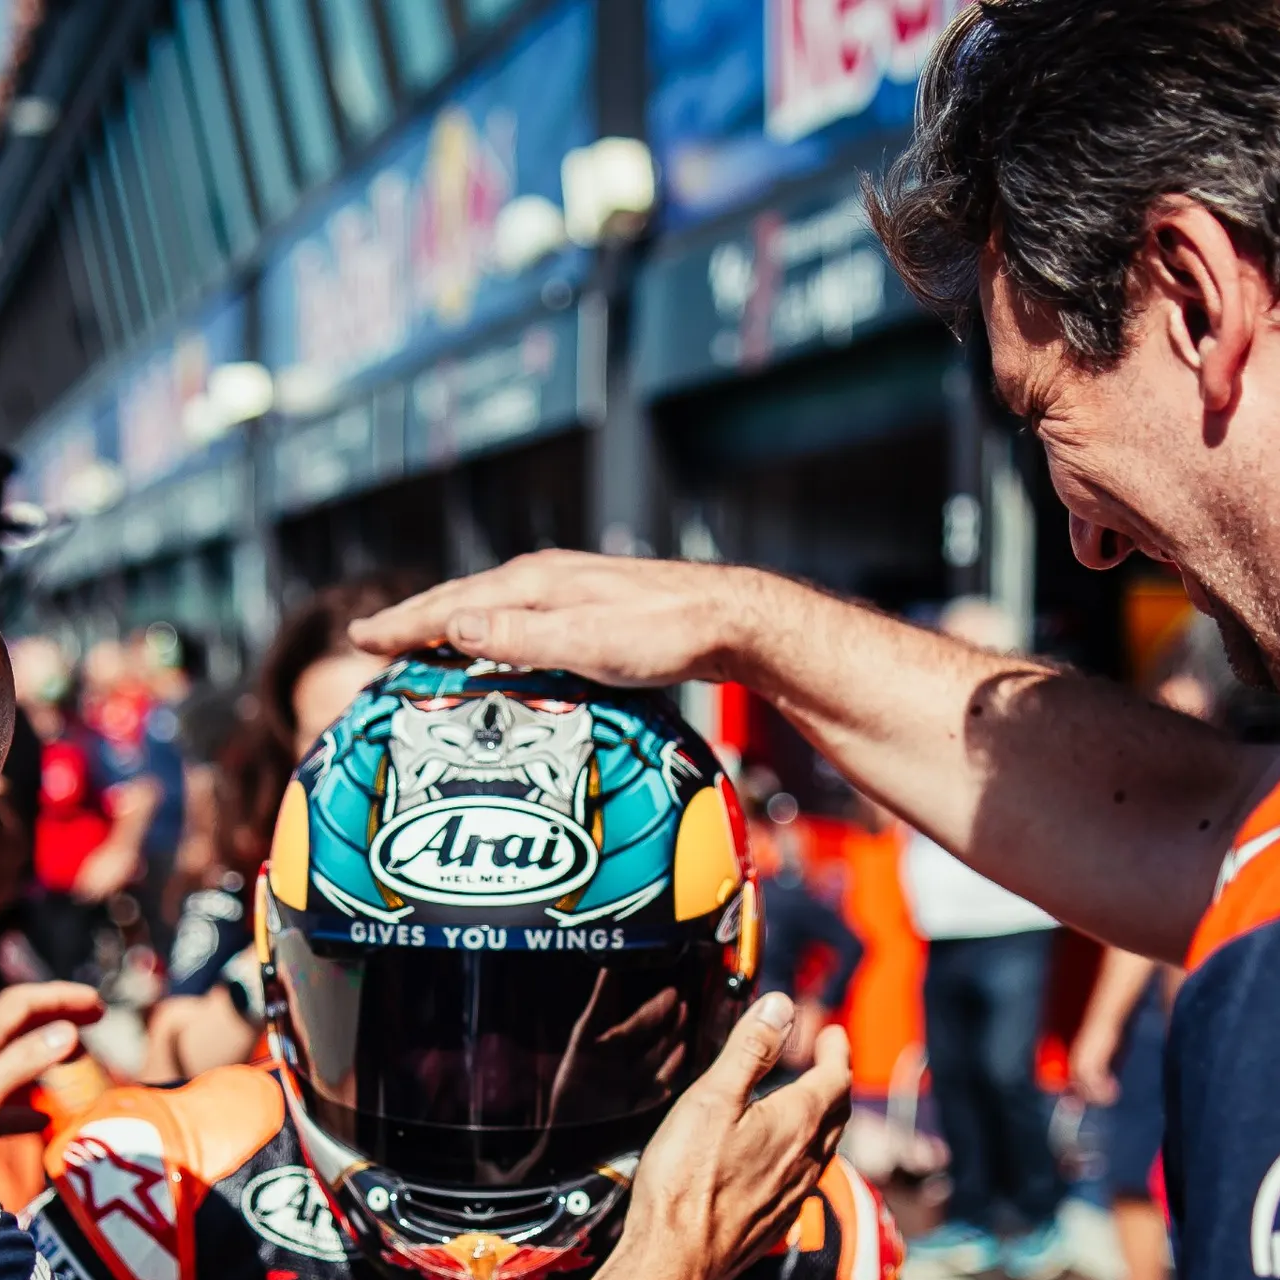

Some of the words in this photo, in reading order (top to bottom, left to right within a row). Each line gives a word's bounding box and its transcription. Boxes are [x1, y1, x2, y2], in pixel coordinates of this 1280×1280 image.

[387, 815, 563, 870] Arai
[350, 921, 426, 947] GIVES
[443, 927, 508, 950] YOU
[523, 928, 626, 950] WINGS
